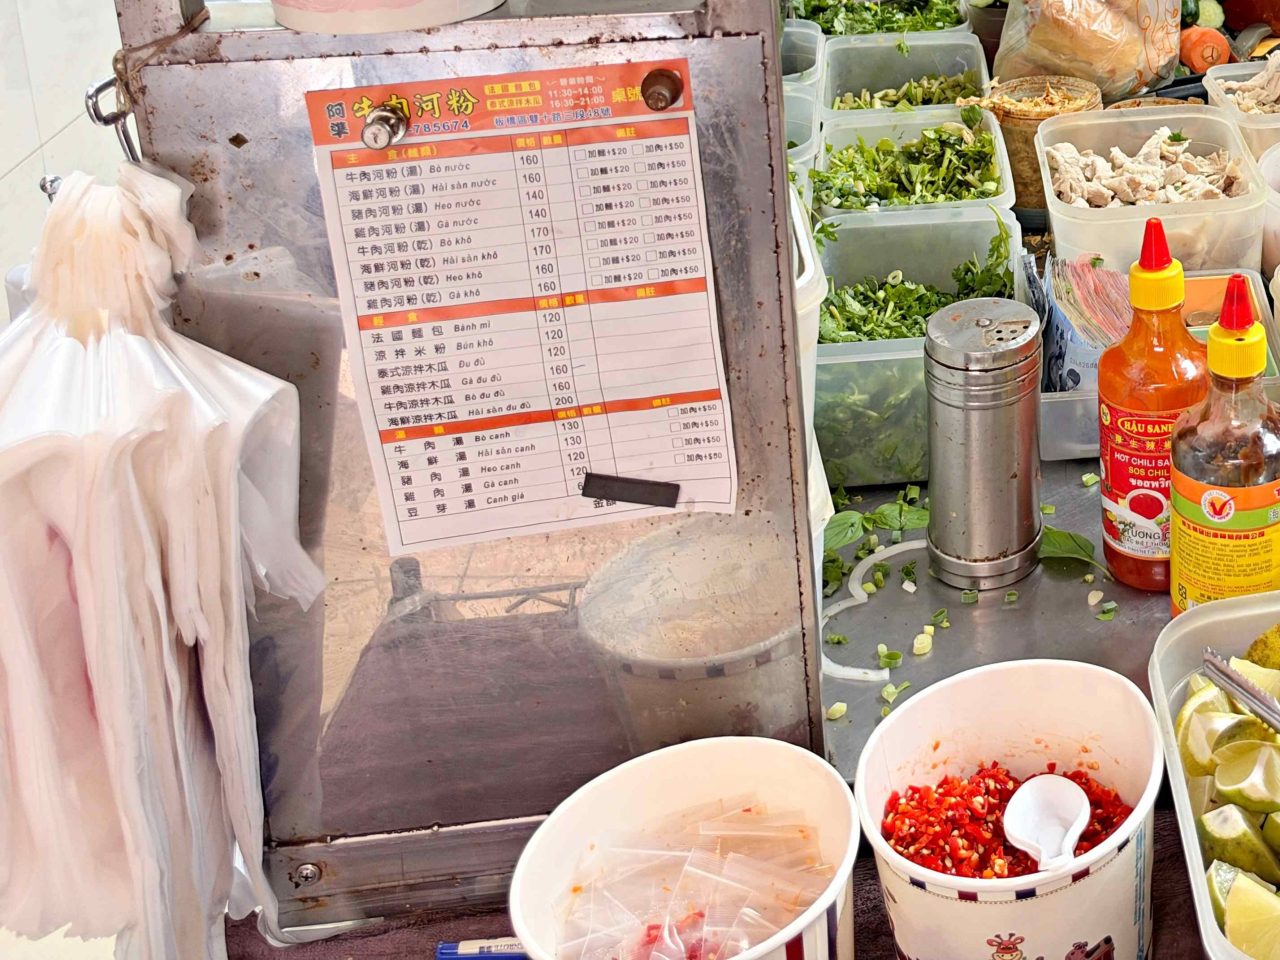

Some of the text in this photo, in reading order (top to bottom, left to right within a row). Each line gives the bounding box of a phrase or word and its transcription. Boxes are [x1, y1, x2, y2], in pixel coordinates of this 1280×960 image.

[520, 154, 538, 165] 160
[523, 172, 541, 183] 160
[526, 189, 544, 201] 140
[529, 208, 547, 219] 140
[530, 226, 549, 238] 170
[533, 244, 551, 256] 170
[535, 263, 554, 274] 160
[538, 281, 556, 292] 160
[542, 312, 561, 323] 120
[545, 329, 563, 340] 120
[547, 346, 566, 357] 120
[550, 364, 568, 376] 160
[552, 381, 571, 392] 160
[555, 396, 573, 406] 200
[561, 421, 579, 431] 130
[489, 431, 511, 440] canh
[564, 435, 582, 446] 130
[515, 443, 536, 453] canh
[567, 450, 585, 461] 120
[1114, 452, 1129, 462] HOT
[1131, 457, 1155, 467] CHILI
[500, 461, 521, 471] canh
[570, 466, 588, 477] 120
[1128, 467, 1145, 476] SOS
[498, 477, 519, 487] canh
[486, 495, 509, 505] Canh
